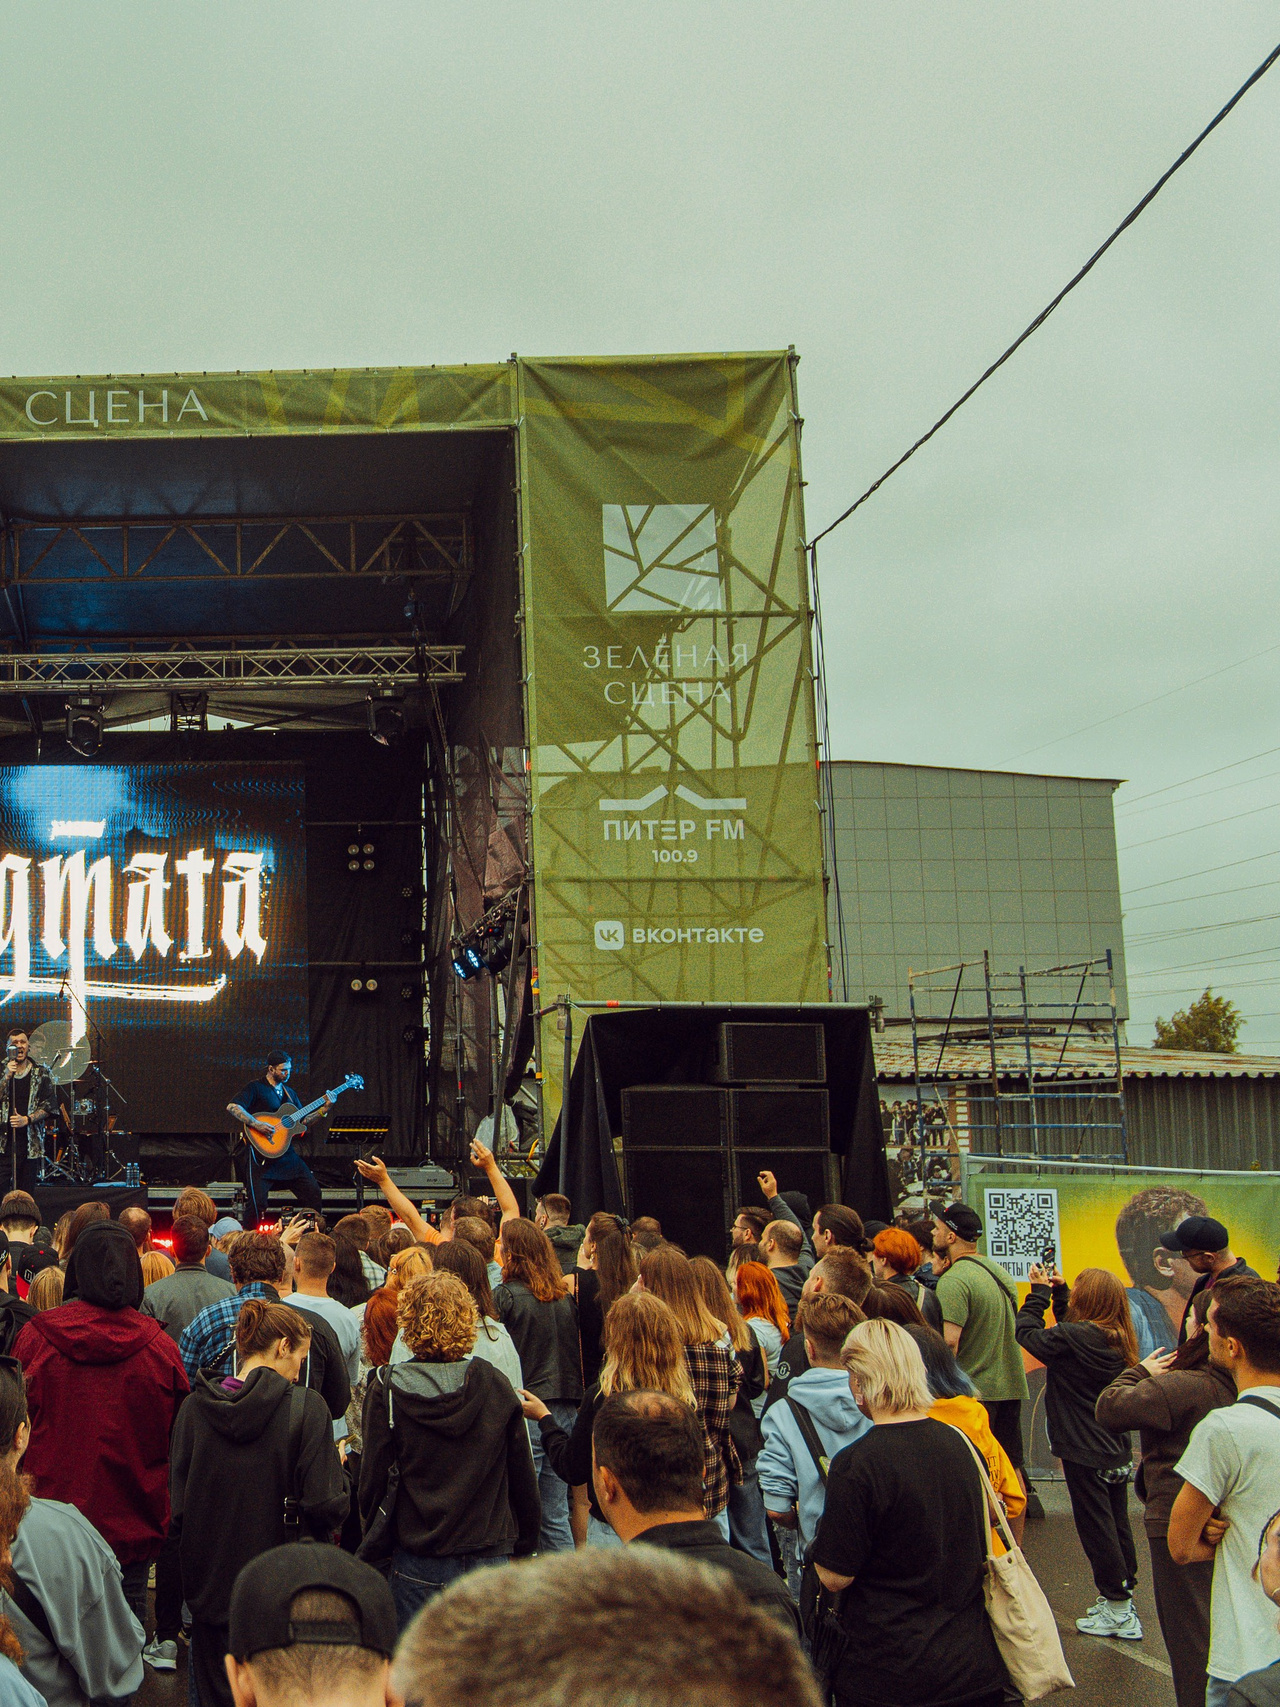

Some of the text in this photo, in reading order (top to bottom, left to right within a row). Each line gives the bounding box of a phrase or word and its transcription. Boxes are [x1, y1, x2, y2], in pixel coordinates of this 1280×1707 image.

[26, 389, 209, 428] СЦЕНА
[583, 638, 748, 669] ЗЕЛЁНАЯ
[604, 681, 732, 707] СЦЕНА
[603, 819, 745, 841] ПИТЕР FM
[651, 850, 698, 863] 100.9
